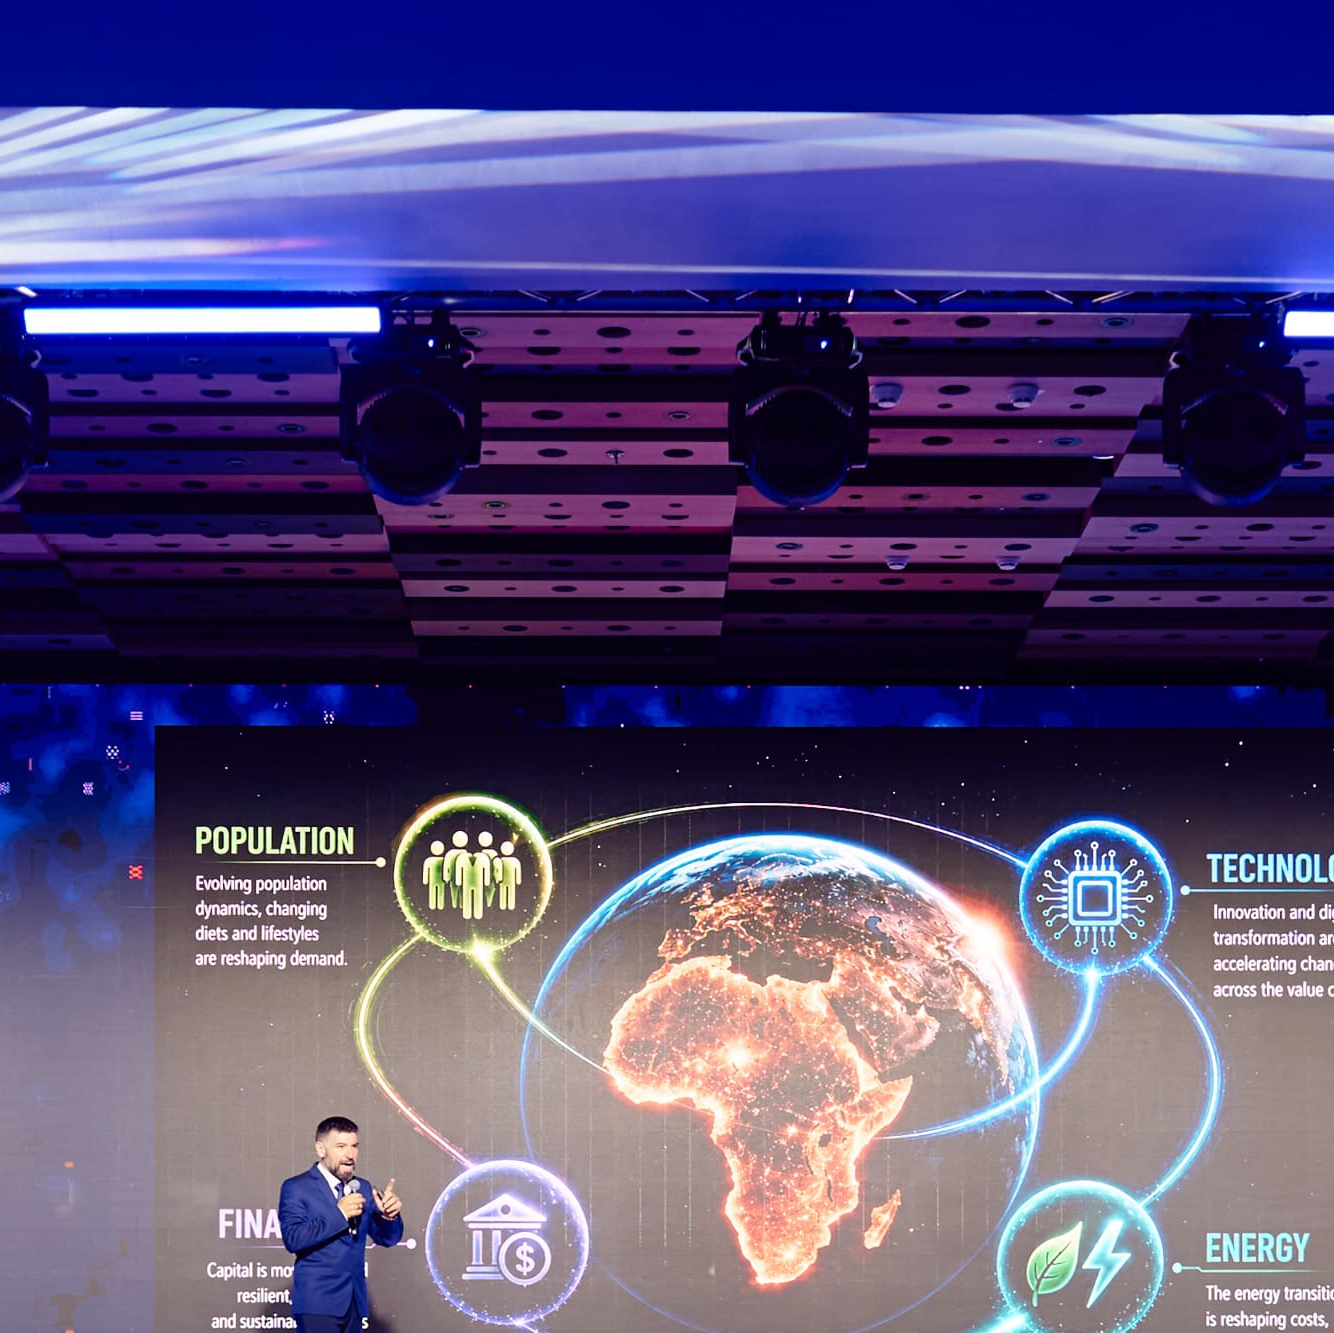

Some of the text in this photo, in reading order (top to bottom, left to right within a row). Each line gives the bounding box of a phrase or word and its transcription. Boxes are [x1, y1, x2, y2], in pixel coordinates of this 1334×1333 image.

[195, 826, 354, 855] POPULATION
[195, 875, 327, 894] Evolving population
[195, 900, 327, 920] dynamics, changing
[1213, 904, 1286, 920] Innovation
[1290, 904, 1315, 920] and
[195, 926, 319, 944] diets and lifestyles
[1213, 929, 1315, 946] transformation
[195, 951, 348, 969] are reshaping demand.
[1213, 955, 1297, 975] accelerating
[1213, 985, 1257, 997] across
[1261, 981, 1283, 997] the
[1287, 981, 1323, 997] value
[218, 1208, 282, 1239] FINA
[1206, 1232, 1310, 1263] ENERGY
[207, 1262, 253, 1281] Capital
[257, 1262, 267, 1278] is
[1205, 1285, 1231, 1301] The
[1234, 1288, 1280, 1305] energy
[211, 1313, 297, 1329] and sustaina
[1205, 1311, 1329, 1330] is reshaping costs,
